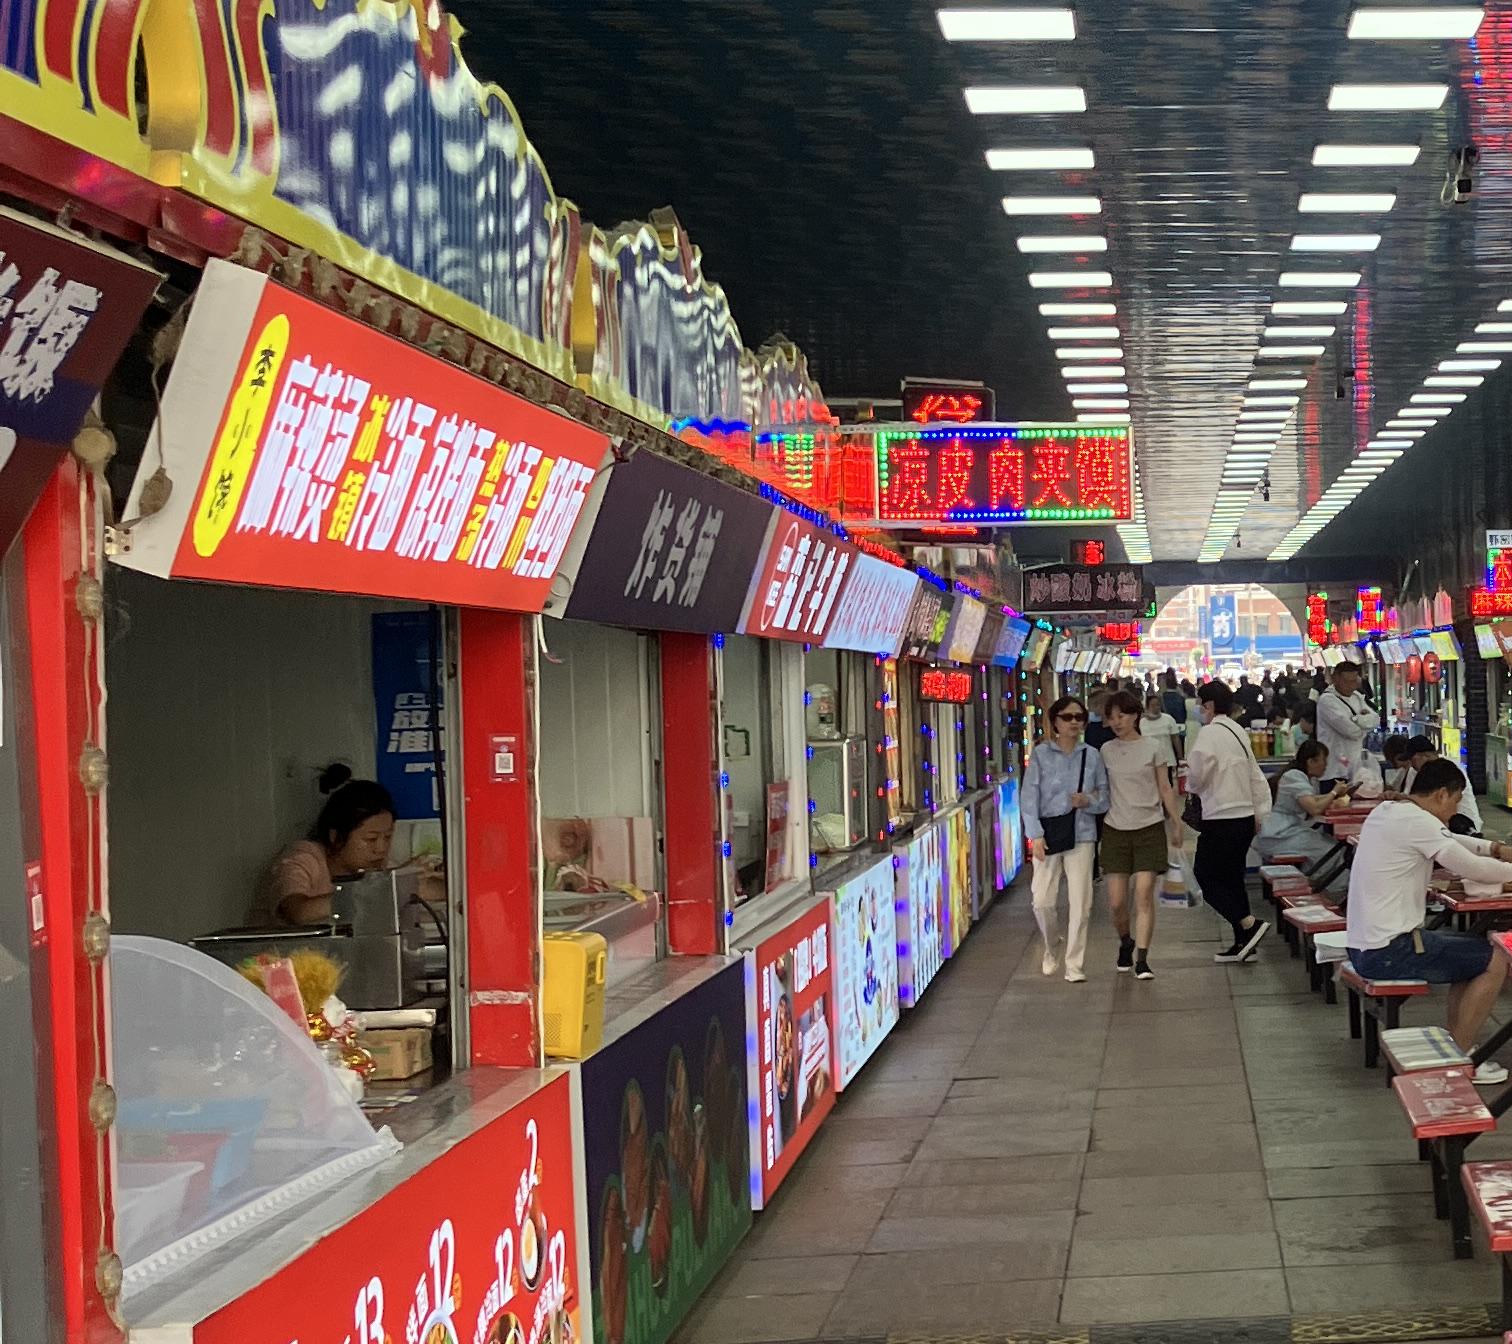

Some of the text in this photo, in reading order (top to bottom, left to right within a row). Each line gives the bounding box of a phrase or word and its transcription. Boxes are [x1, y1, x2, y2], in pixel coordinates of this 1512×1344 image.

[235, 354, 372, 543] 麻辣烫
[344, 396, 438, 552] 冷面
[394, 412, 498, 563] 凉拌面
[467, 441, 543, 570] 冷面
[889, 437, 1116, 510] 凉皮肉夹馍
[501, 457, 555, 570] 四川
[512, 457, 597, 579] 担担面
[427, 1217, 456, 1316] 12
